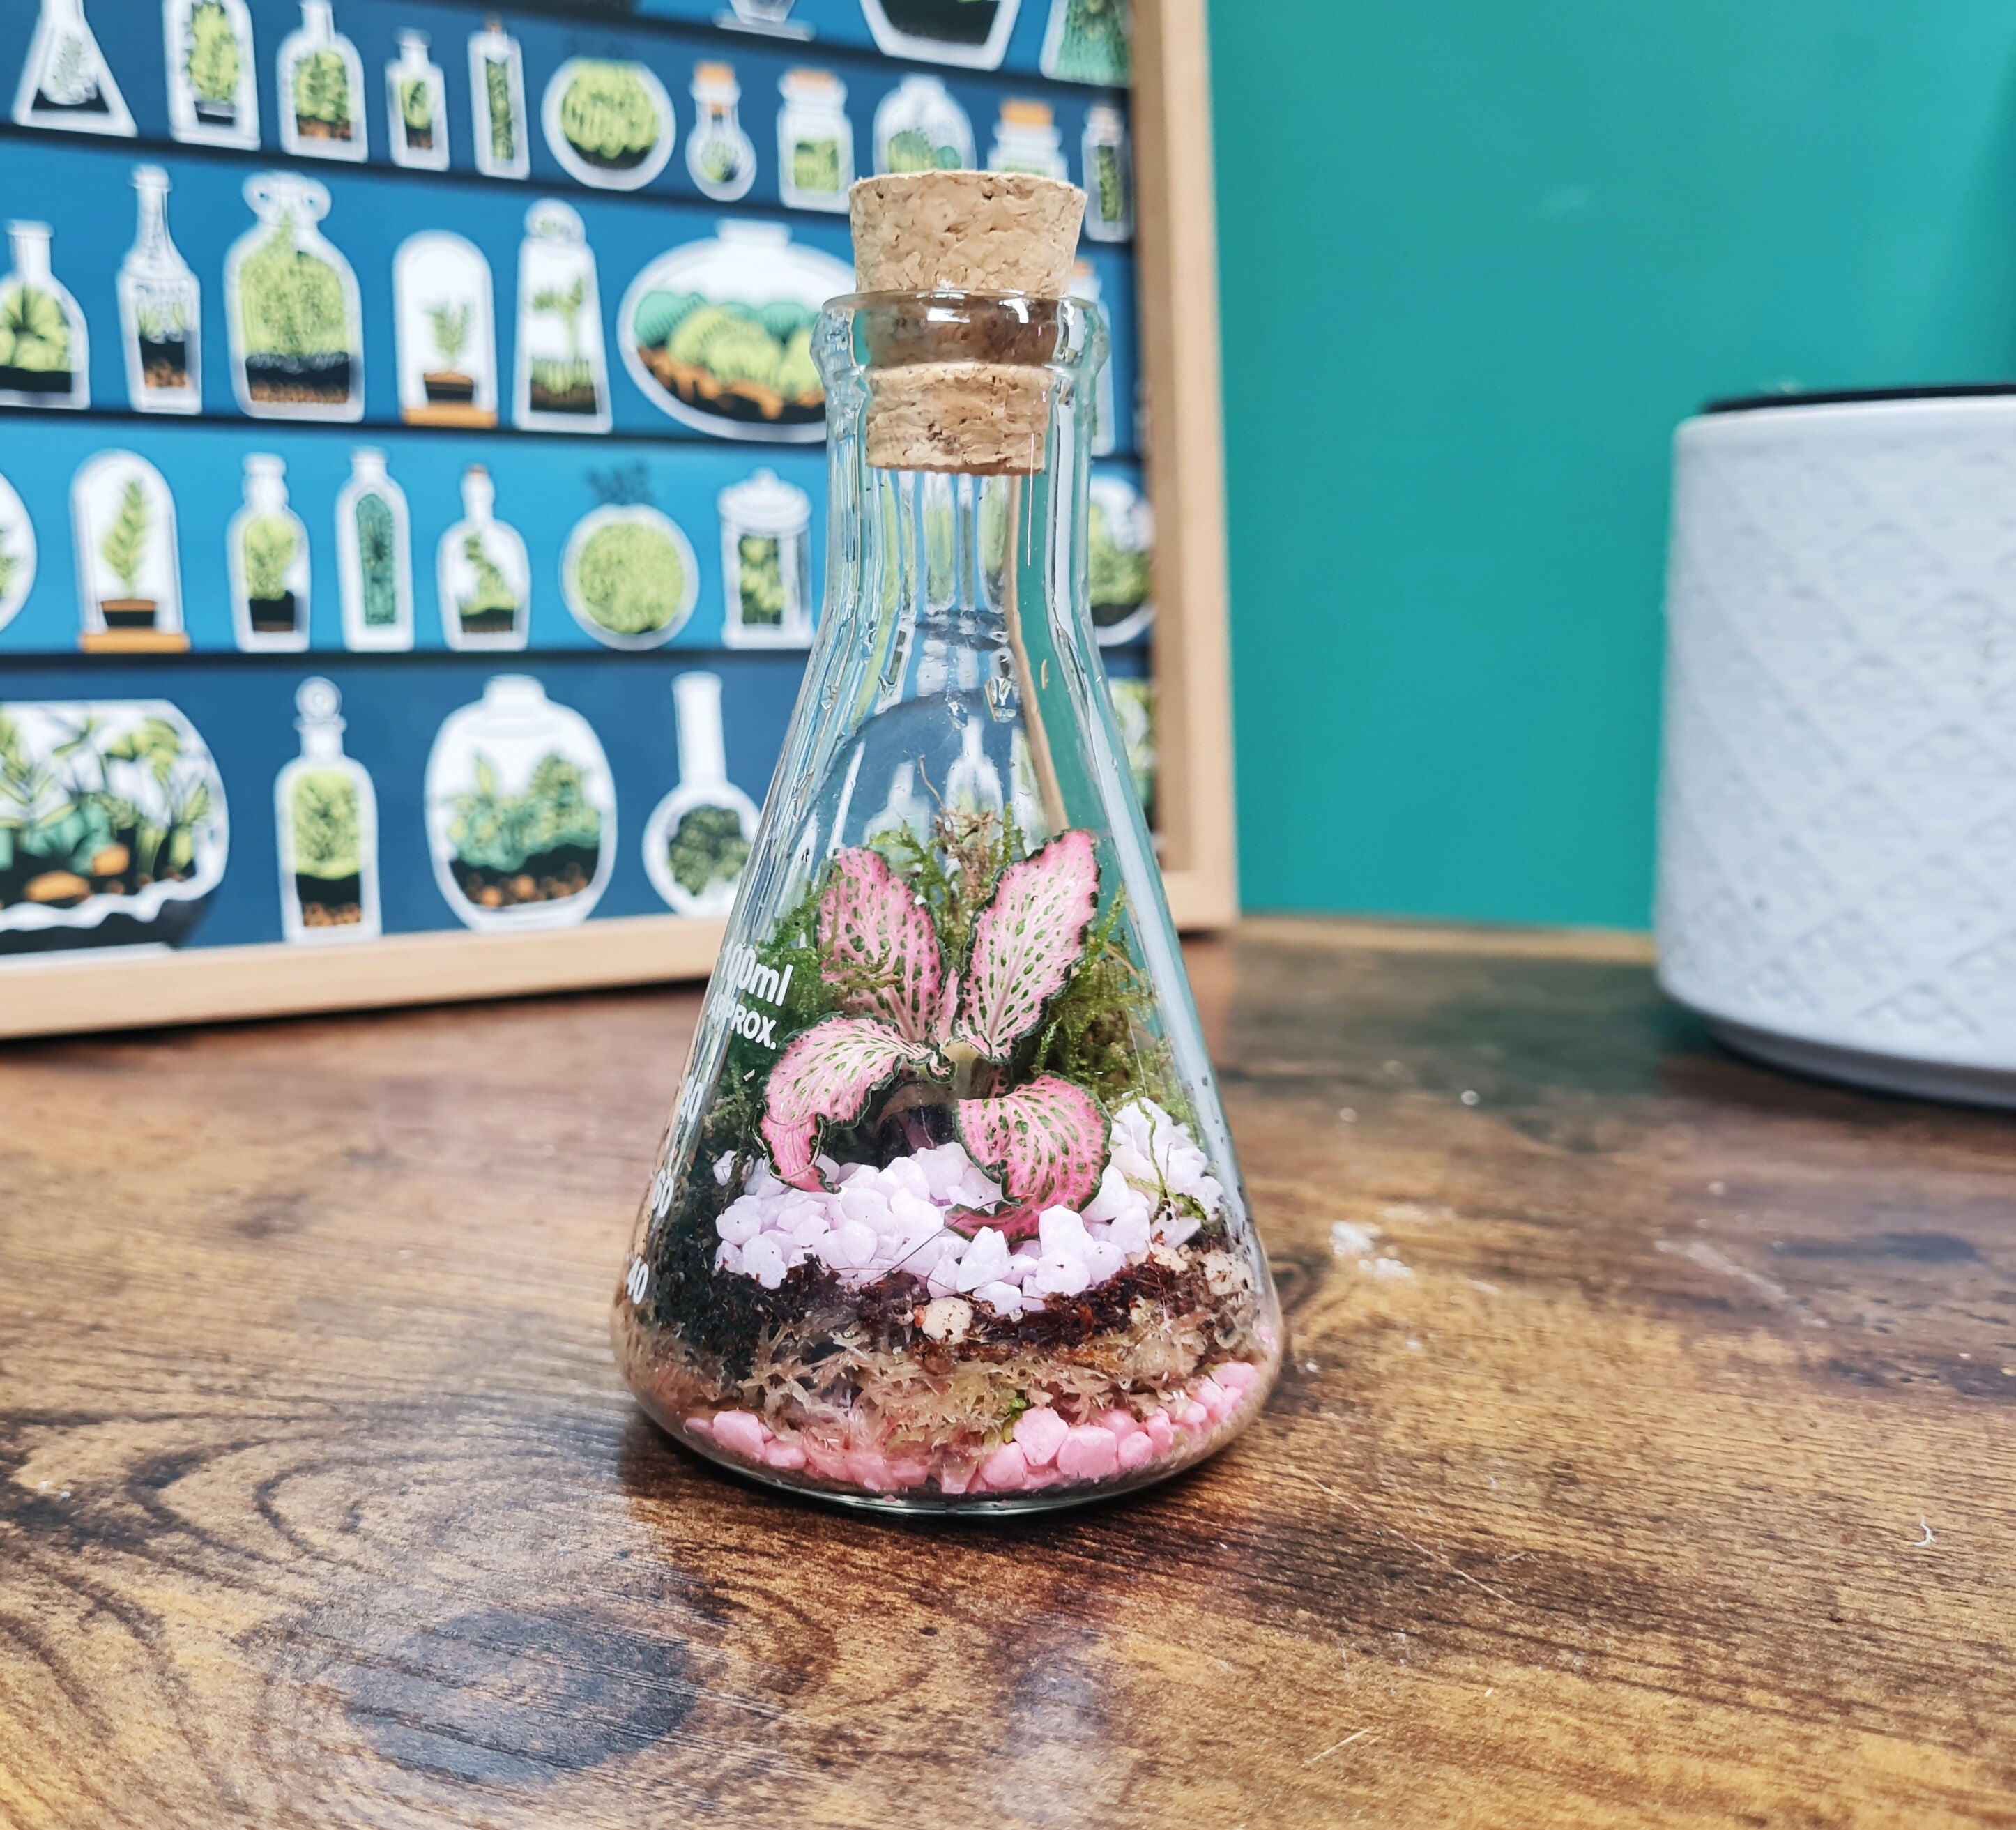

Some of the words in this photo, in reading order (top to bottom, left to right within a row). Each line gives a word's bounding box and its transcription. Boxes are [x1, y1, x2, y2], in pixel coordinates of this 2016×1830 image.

[680, 1075, 703, 1122] 80
[652, 1168, 674, 1217] 60
[627, 1256, 649, 1304] 40
